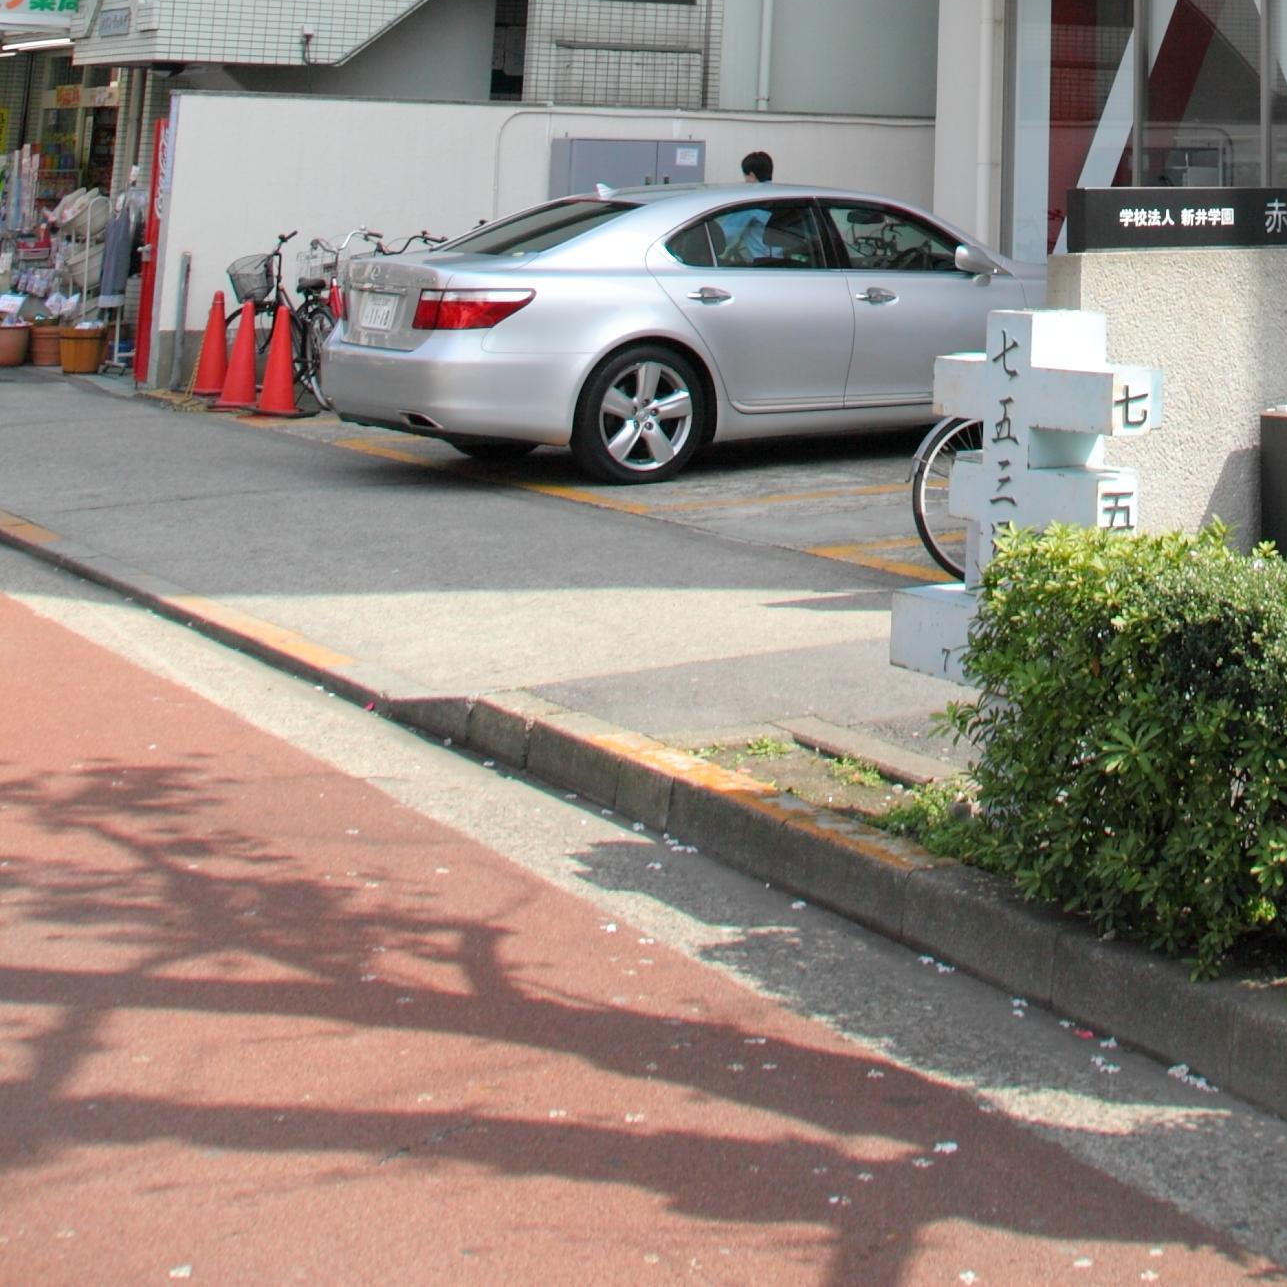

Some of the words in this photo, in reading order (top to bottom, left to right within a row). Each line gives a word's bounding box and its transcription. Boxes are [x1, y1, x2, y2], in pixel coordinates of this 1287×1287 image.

[1119, 208, 1175, 227] 学校法人
[1181, 208, 1235, 227] 新井学園
